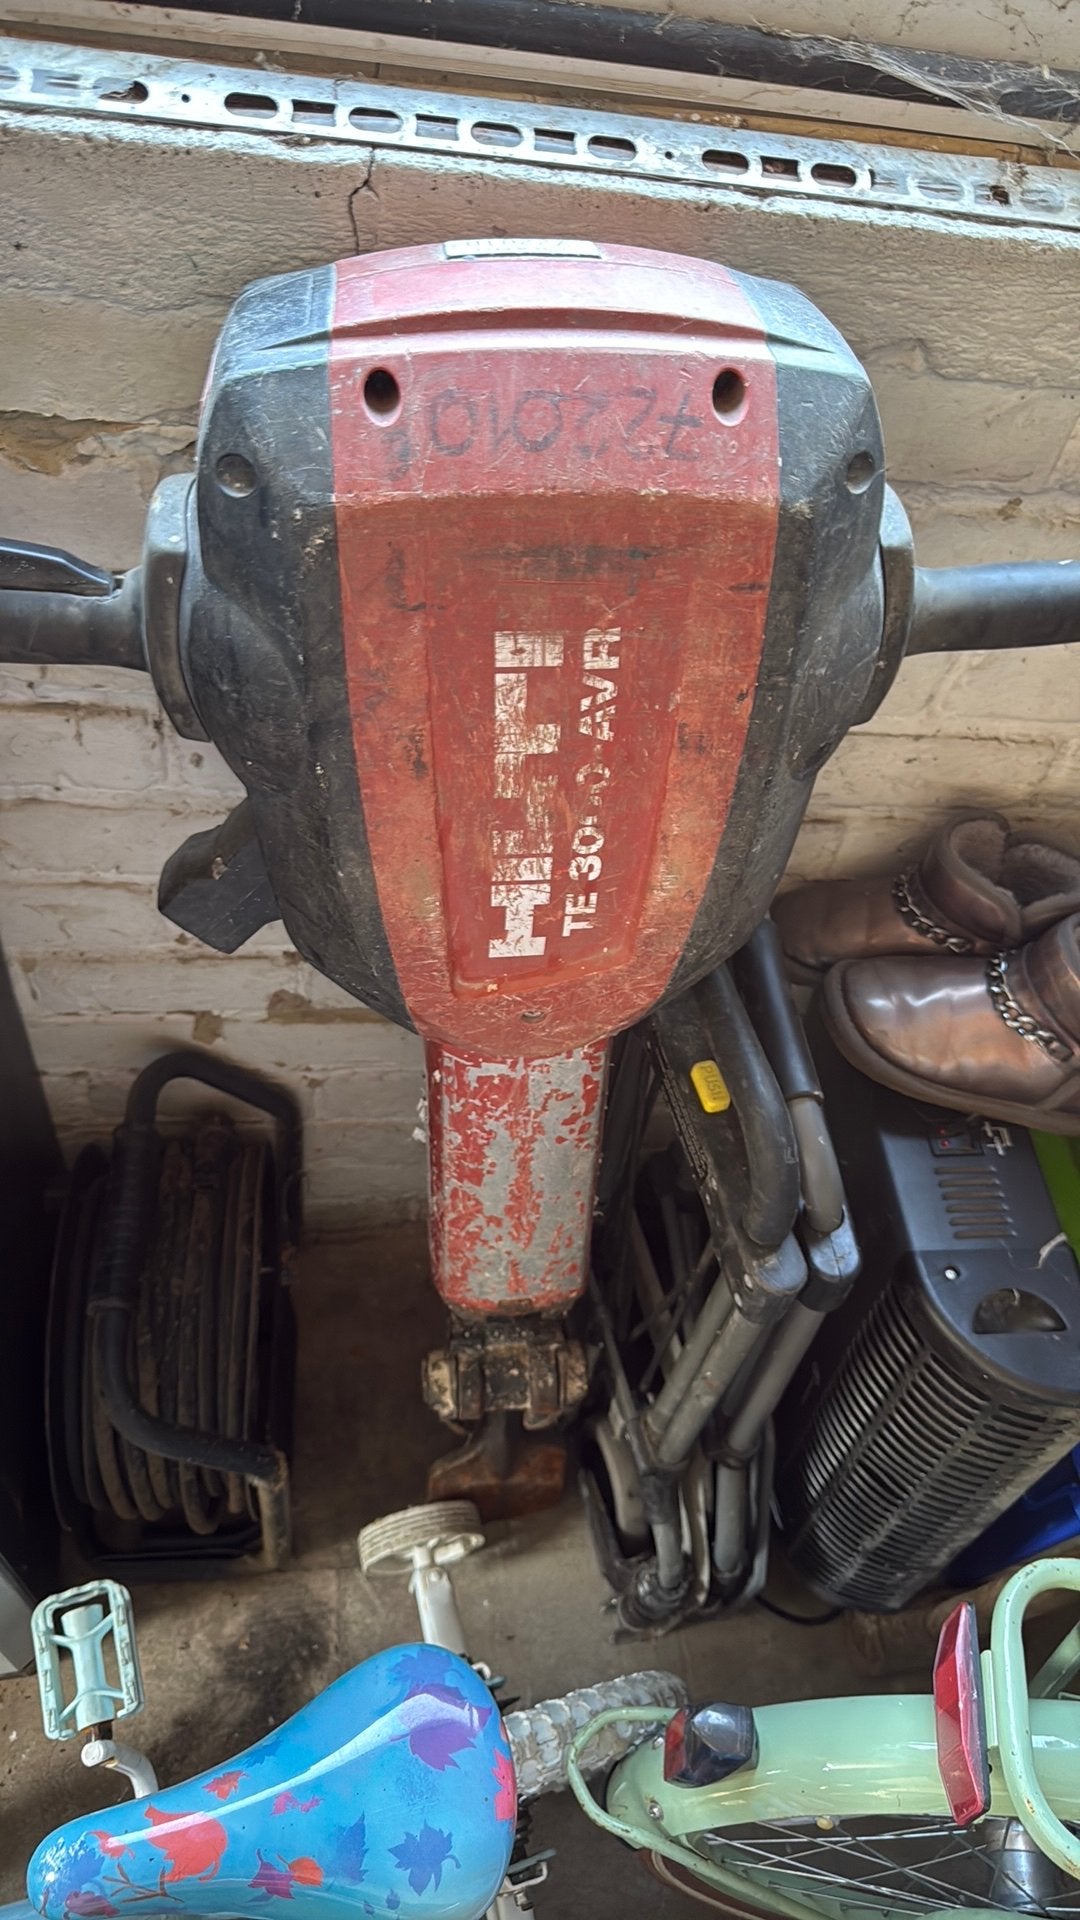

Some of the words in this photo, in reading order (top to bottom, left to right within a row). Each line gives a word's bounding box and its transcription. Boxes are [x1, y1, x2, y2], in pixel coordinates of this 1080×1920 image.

[488, 630, 564, 958] HILTI
[562, 892, 599, 937] TE
[700, 1064, 725, 1101] PUSH
